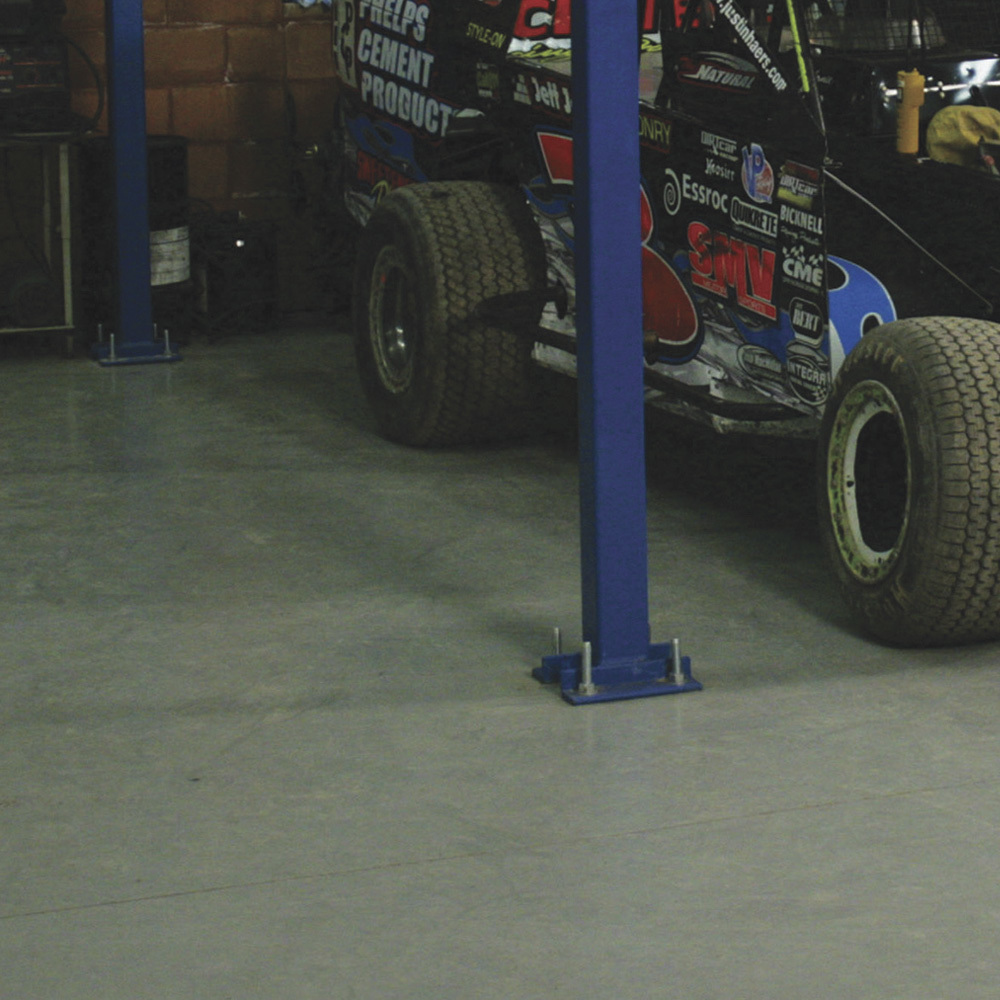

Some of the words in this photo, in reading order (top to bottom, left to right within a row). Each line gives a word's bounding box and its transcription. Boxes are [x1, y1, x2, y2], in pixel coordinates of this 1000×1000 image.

[357, 28, 434, 88] CEMENT
[361, 70, 454, 137] PRODUCT
[682, 173, 729, 214] Essroc
[779, 203, 824, 236] BICKNELL
[782, 257, 824, 287] CME
